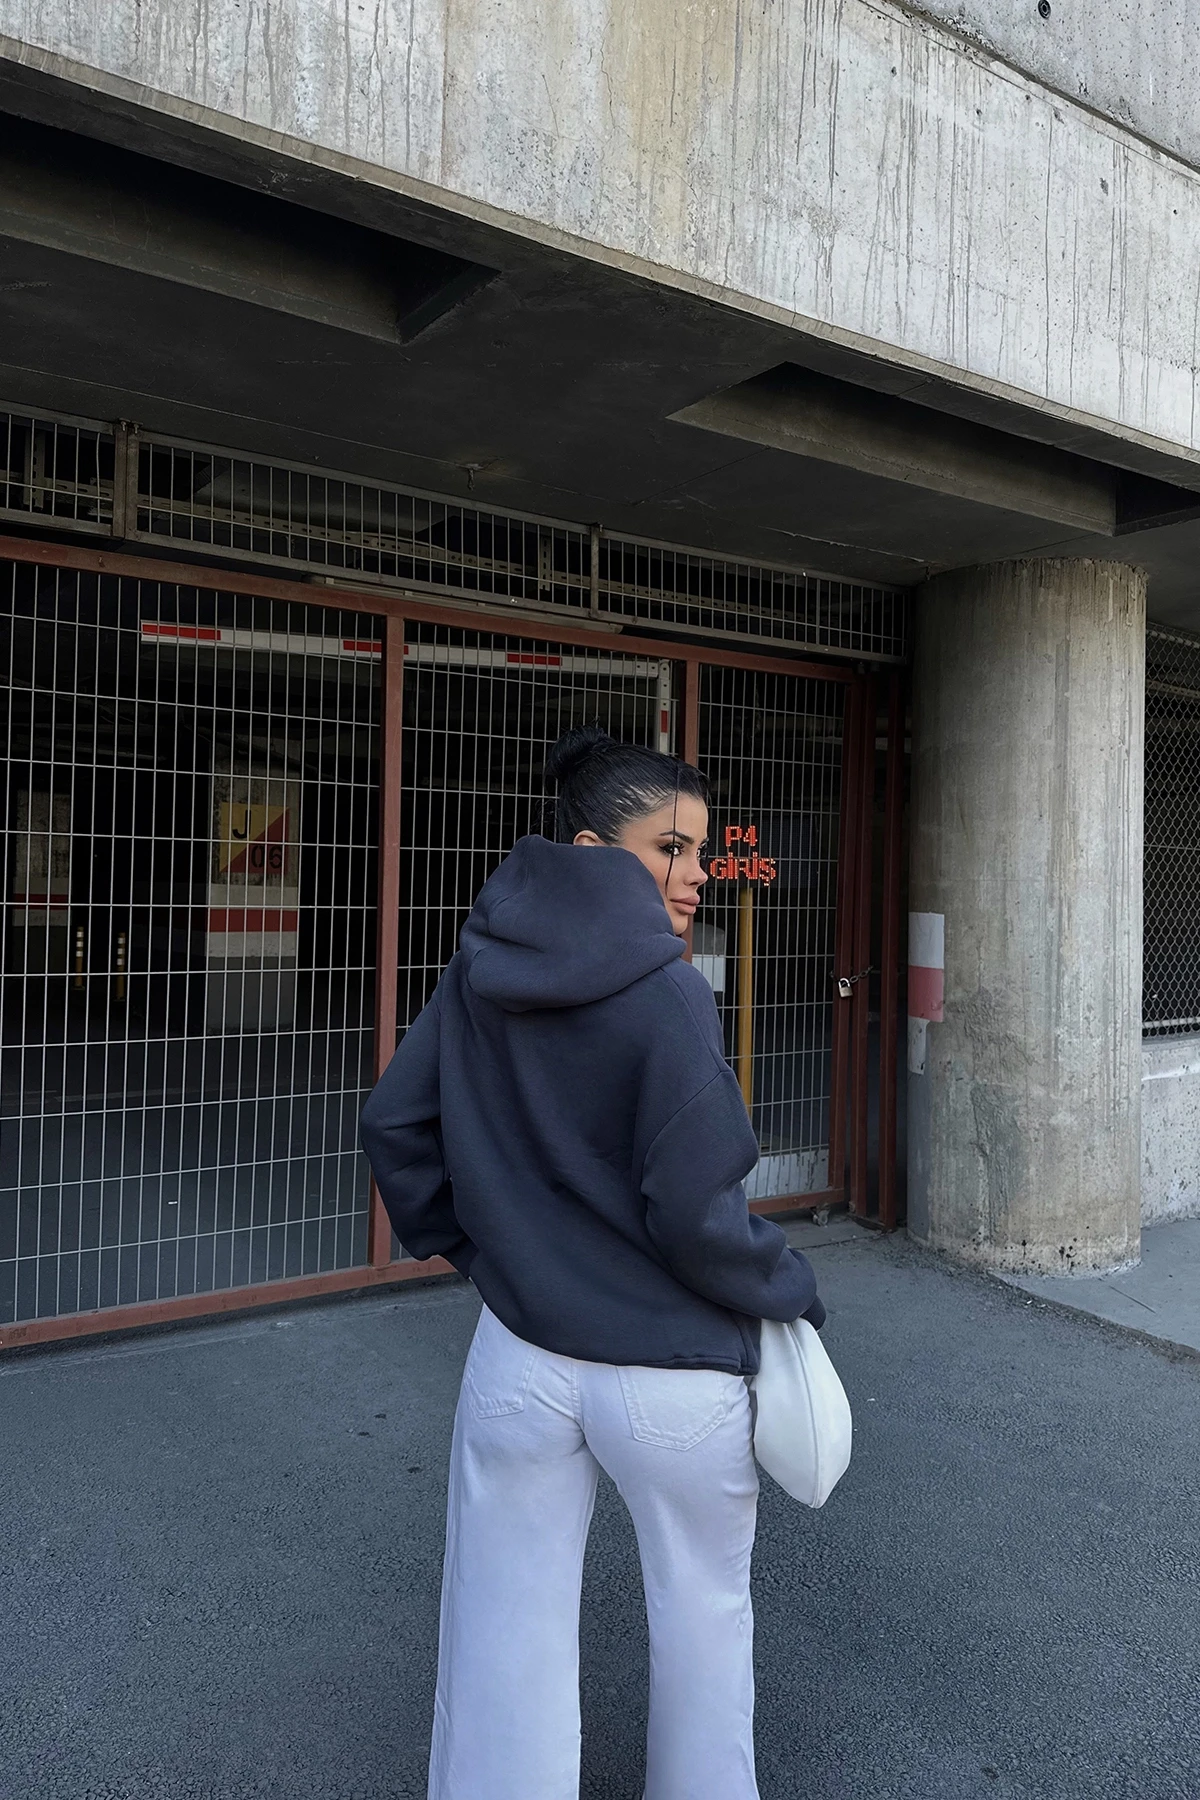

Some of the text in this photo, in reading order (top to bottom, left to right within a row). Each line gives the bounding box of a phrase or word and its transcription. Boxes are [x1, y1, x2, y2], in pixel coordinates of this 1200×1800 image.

[232, 809, 252, 839] J
[725, 825, 758, 847] P4
[251, 845, 284, 869] 06
[710, 852, 776, 886] GİRİŞ
